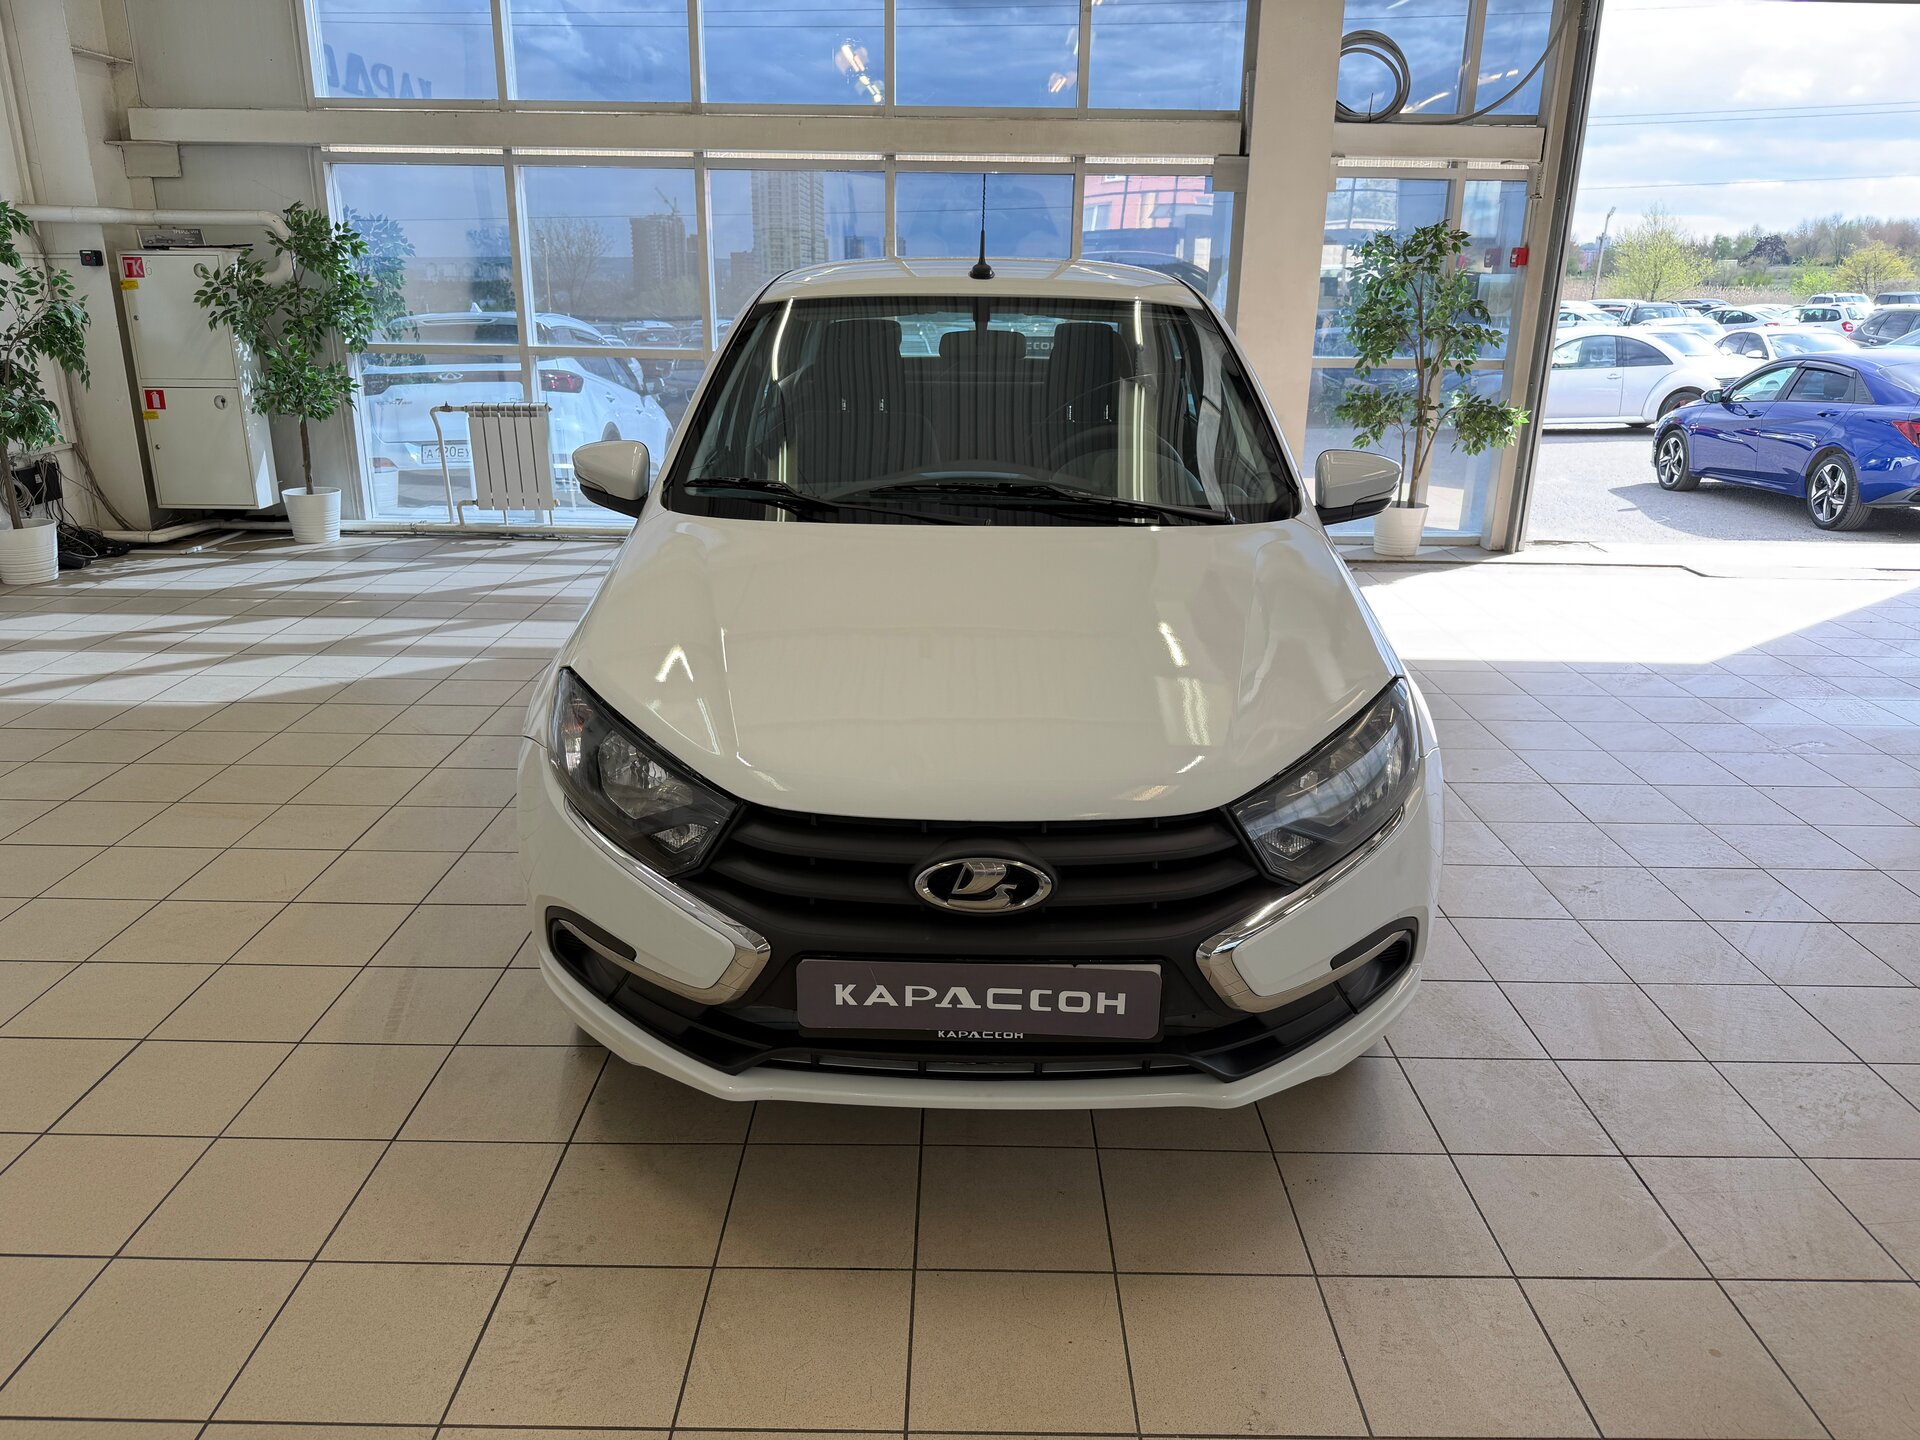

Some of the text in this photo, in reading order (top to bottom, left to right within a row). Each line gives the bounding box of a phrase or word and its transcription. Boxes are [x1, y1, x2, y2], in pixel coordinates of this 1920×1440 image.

[123, 259, 144, 276] ПК
[834, 983, 1126, 1015] КАРАССОН
[937, 1030, 1024, 1039] КАРАССОН
